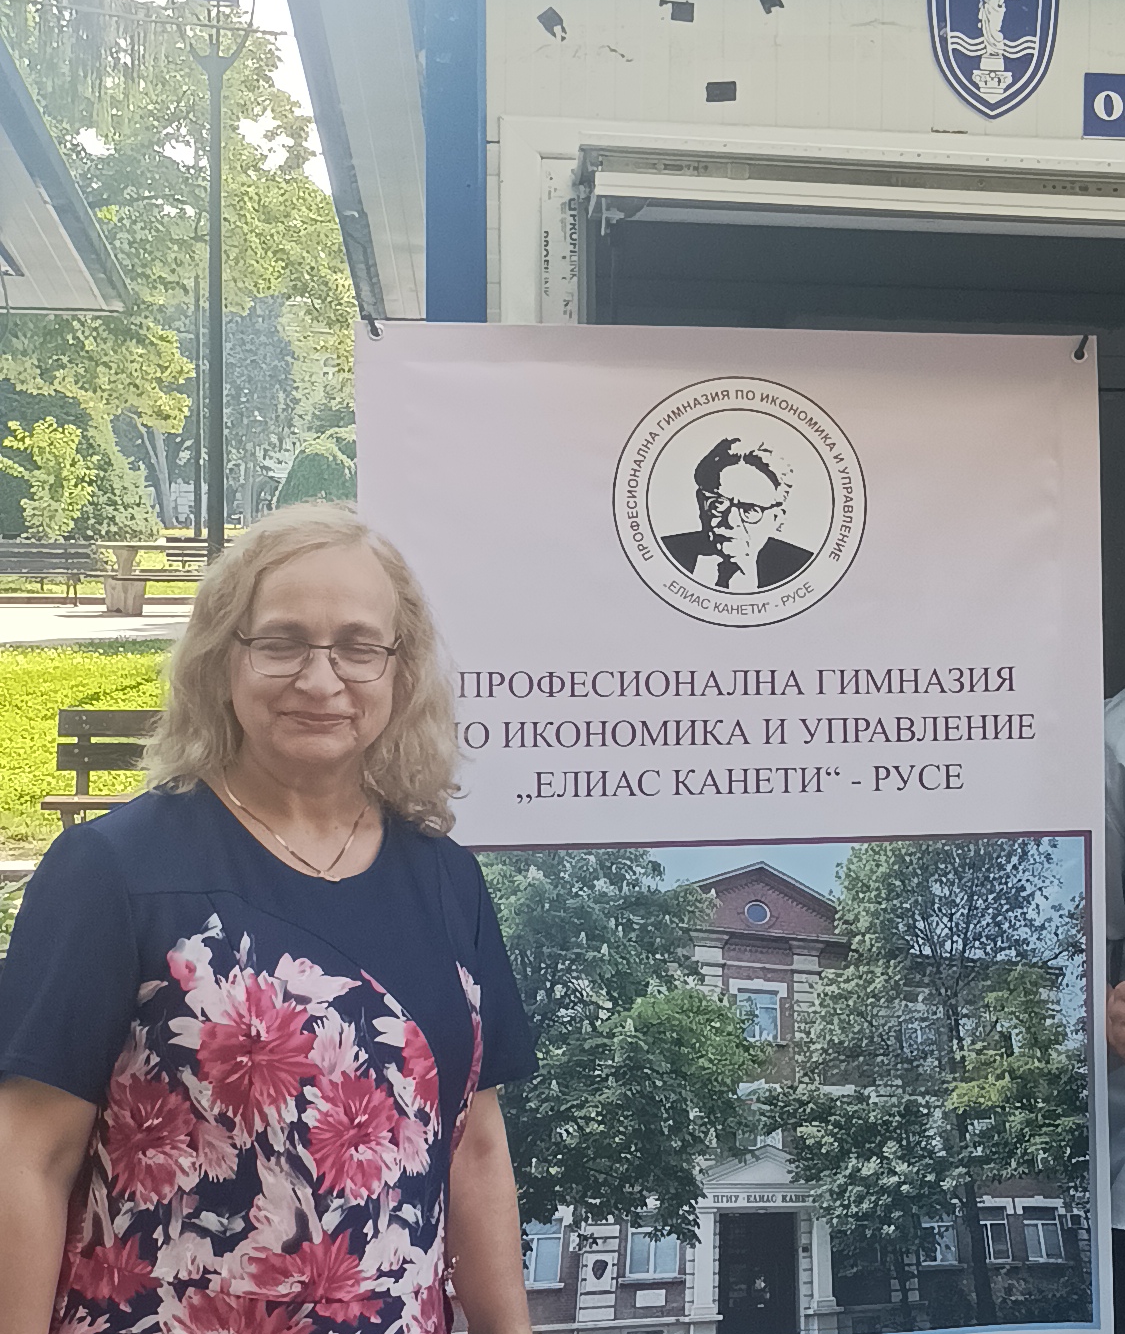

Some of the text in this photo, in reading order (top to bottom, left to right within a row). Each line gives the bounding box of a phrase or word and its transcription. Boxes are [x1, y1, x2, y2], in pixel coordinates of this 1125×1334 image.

[626, 389, 854, 562] ПРОФЕСИОНАЛНА ГИМНАЗИЯ ПО ИКОНОМИКА И УПРАВЛЕНИЕ
[781, 581, 815, 607] РУСЕ
[457, 666, 1016, 699] ПРОФЕСИОНАЛНА ГИМНАЗИЯ
[502, 719, 751, 749] ИКОНОМИКА
[762, 718, 788, 745] И
[798, 713, 1037, 745] УПРАВЛЕНИЕ
[516, 768, 661, 804] „ЕЛИАС
[672, 766, 841, 796] КАНЕТИ“
[872, 763, 965, 792] РУСЕ
